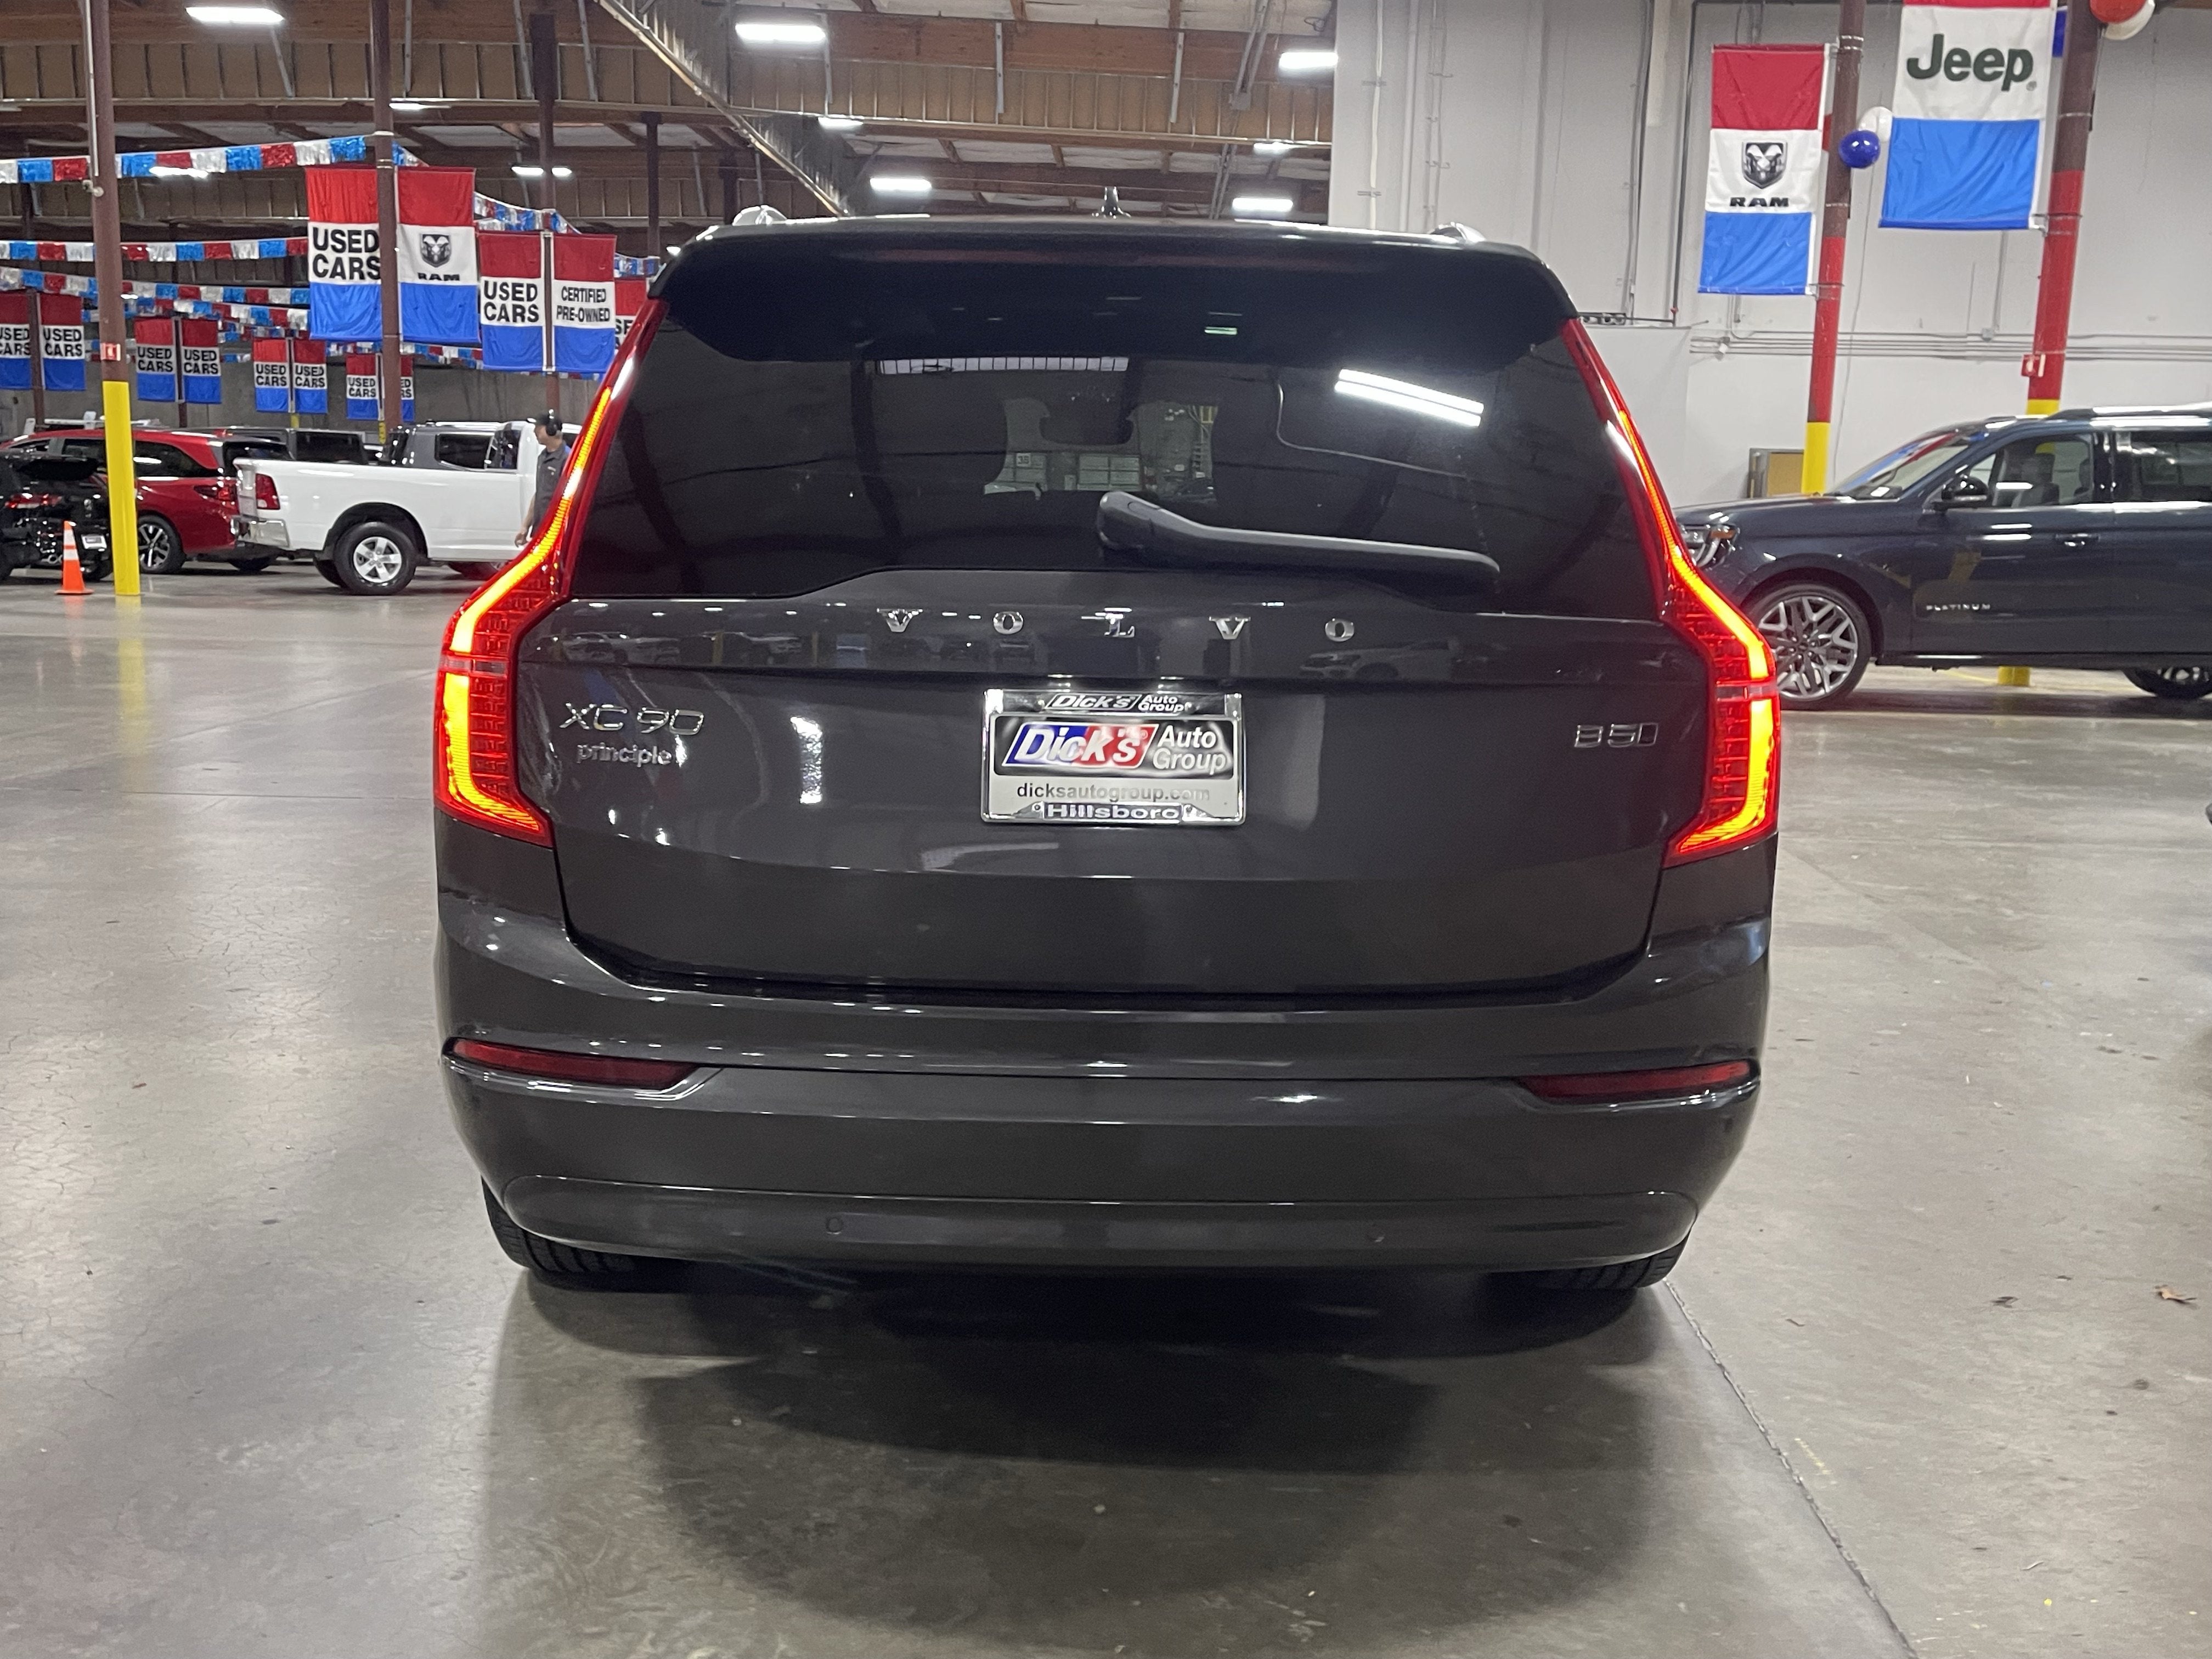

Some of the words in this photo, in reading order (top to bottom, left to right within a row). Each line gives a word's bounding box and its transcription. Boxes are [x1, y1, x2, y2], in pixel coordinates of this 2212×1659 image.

[1906, 33, 2034, 92] Jeep
[1730, 197, 1789, 207] RAM
[313, 227, 380, 253] USED
[313, 253, 381, 280] CARS
[417, 272, 460, 281] RAM
[484, 280, 538, 302] USED
[561, 286, 606, 303] CERTIFIED
[484, 302, 539, 323] CARS
[557, 305, 610, 322] PRE-OWNED
[0, 328, 29, 341] SED
[43, 329, 82, 341] USED
[44, 343, 82, 356] CARS
[138, 347, 172, 359] USED
[184, 349, 217, 362] USED
[138, 360, 173, 372] CARS
[184, 363, 218, 375] CARS
[256, 364, 286, 375] USED
[296, 365, 324, 376] USED
[256, 375, 287, 386] CARS
[296, 376, 325, 387] CARS
[348, 377, 376, 387] USED
[349, 387, 376, 398] CARS
[878, 609, 1355, 642] VOLVO
[1052, 695, 1131, 708] Dick's
[1142, 695, 1177, 704] Auto
[1138, 702, 1184, 712] Group
[1014, 726, 1142, 762] Dick's
[1158, 725, 1216, 748] Auto
[576, 742, 672, 768] principle
[1153, 748, 1227, 775] Group
[1017, 783, 1210, 803] dicksautogroup.com
[1047, 804, 1180, 820] Hillsboro
